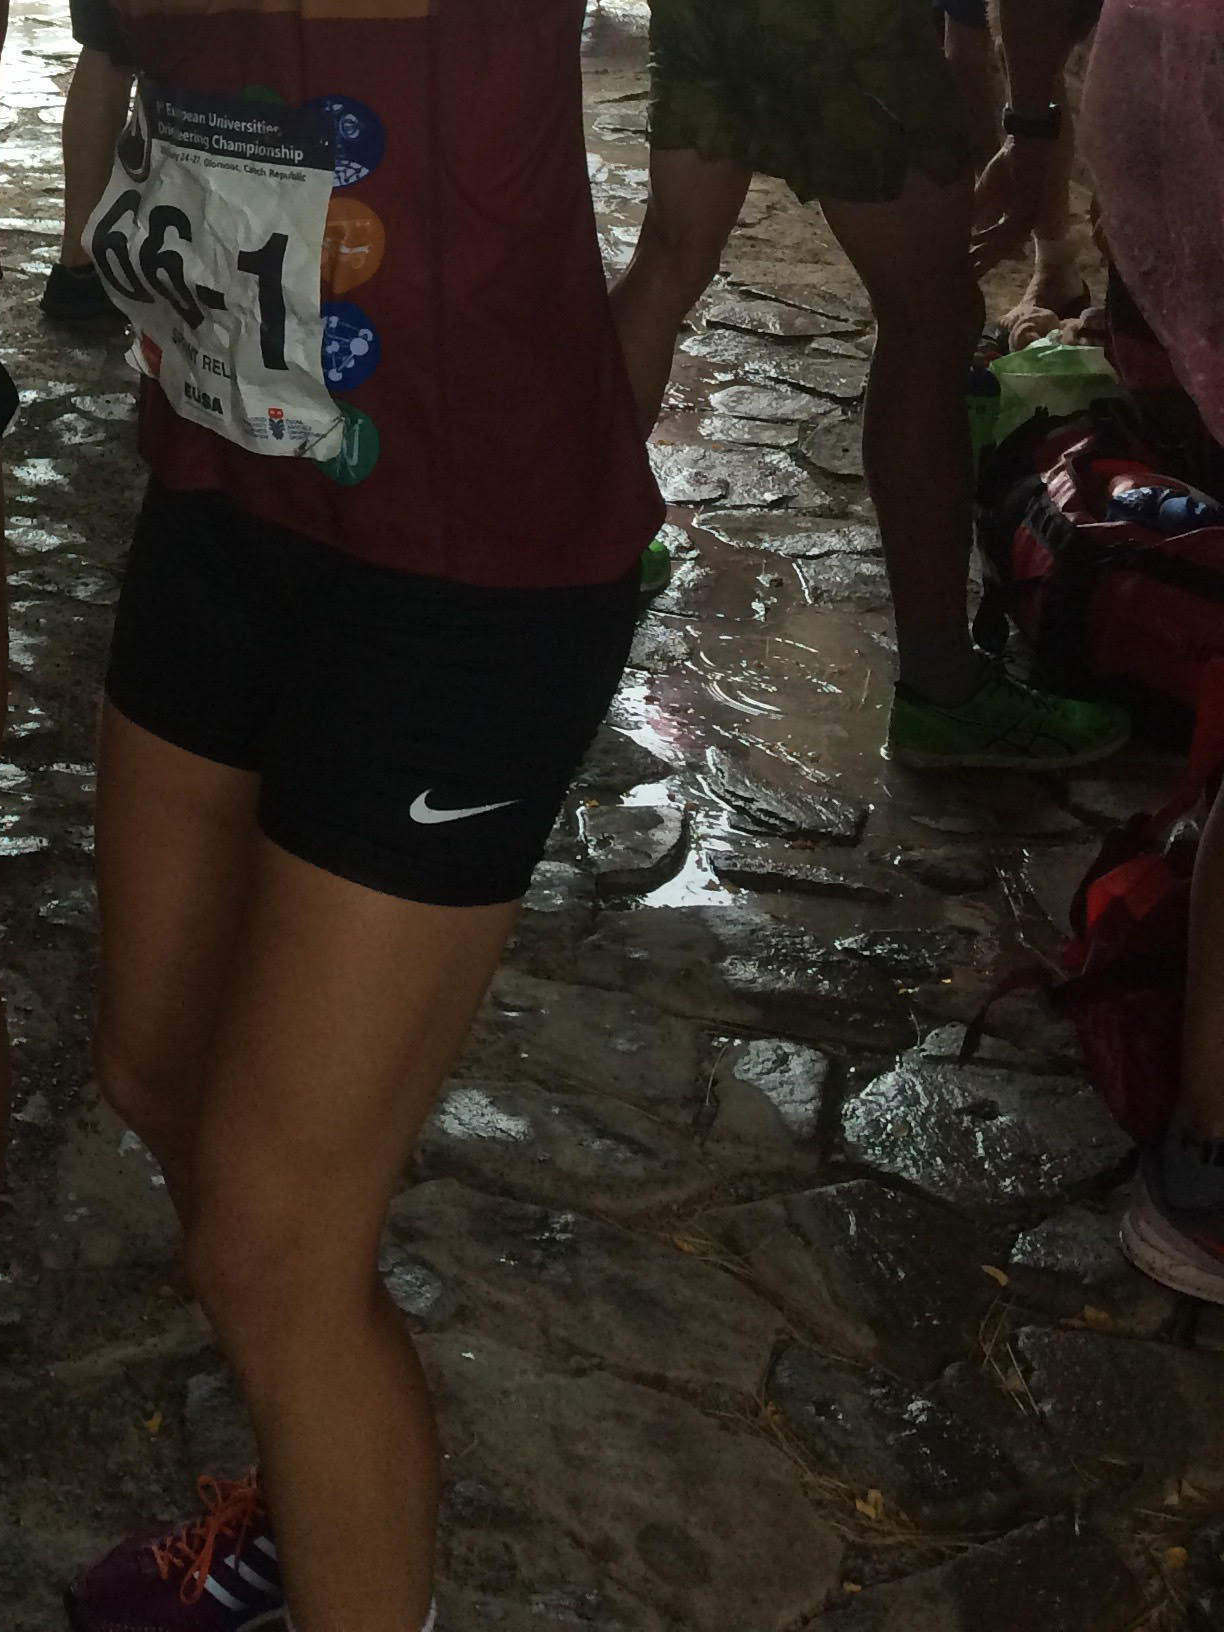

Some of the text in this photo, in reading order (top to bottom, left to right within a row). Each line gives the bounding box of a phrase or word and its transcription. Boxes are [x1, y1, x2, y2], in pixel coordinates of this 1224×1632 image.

[212, 134, 304, 164] Championship
[92, 189, 290, 371] 66-1
[184, 381, 224, 415] EUSA
